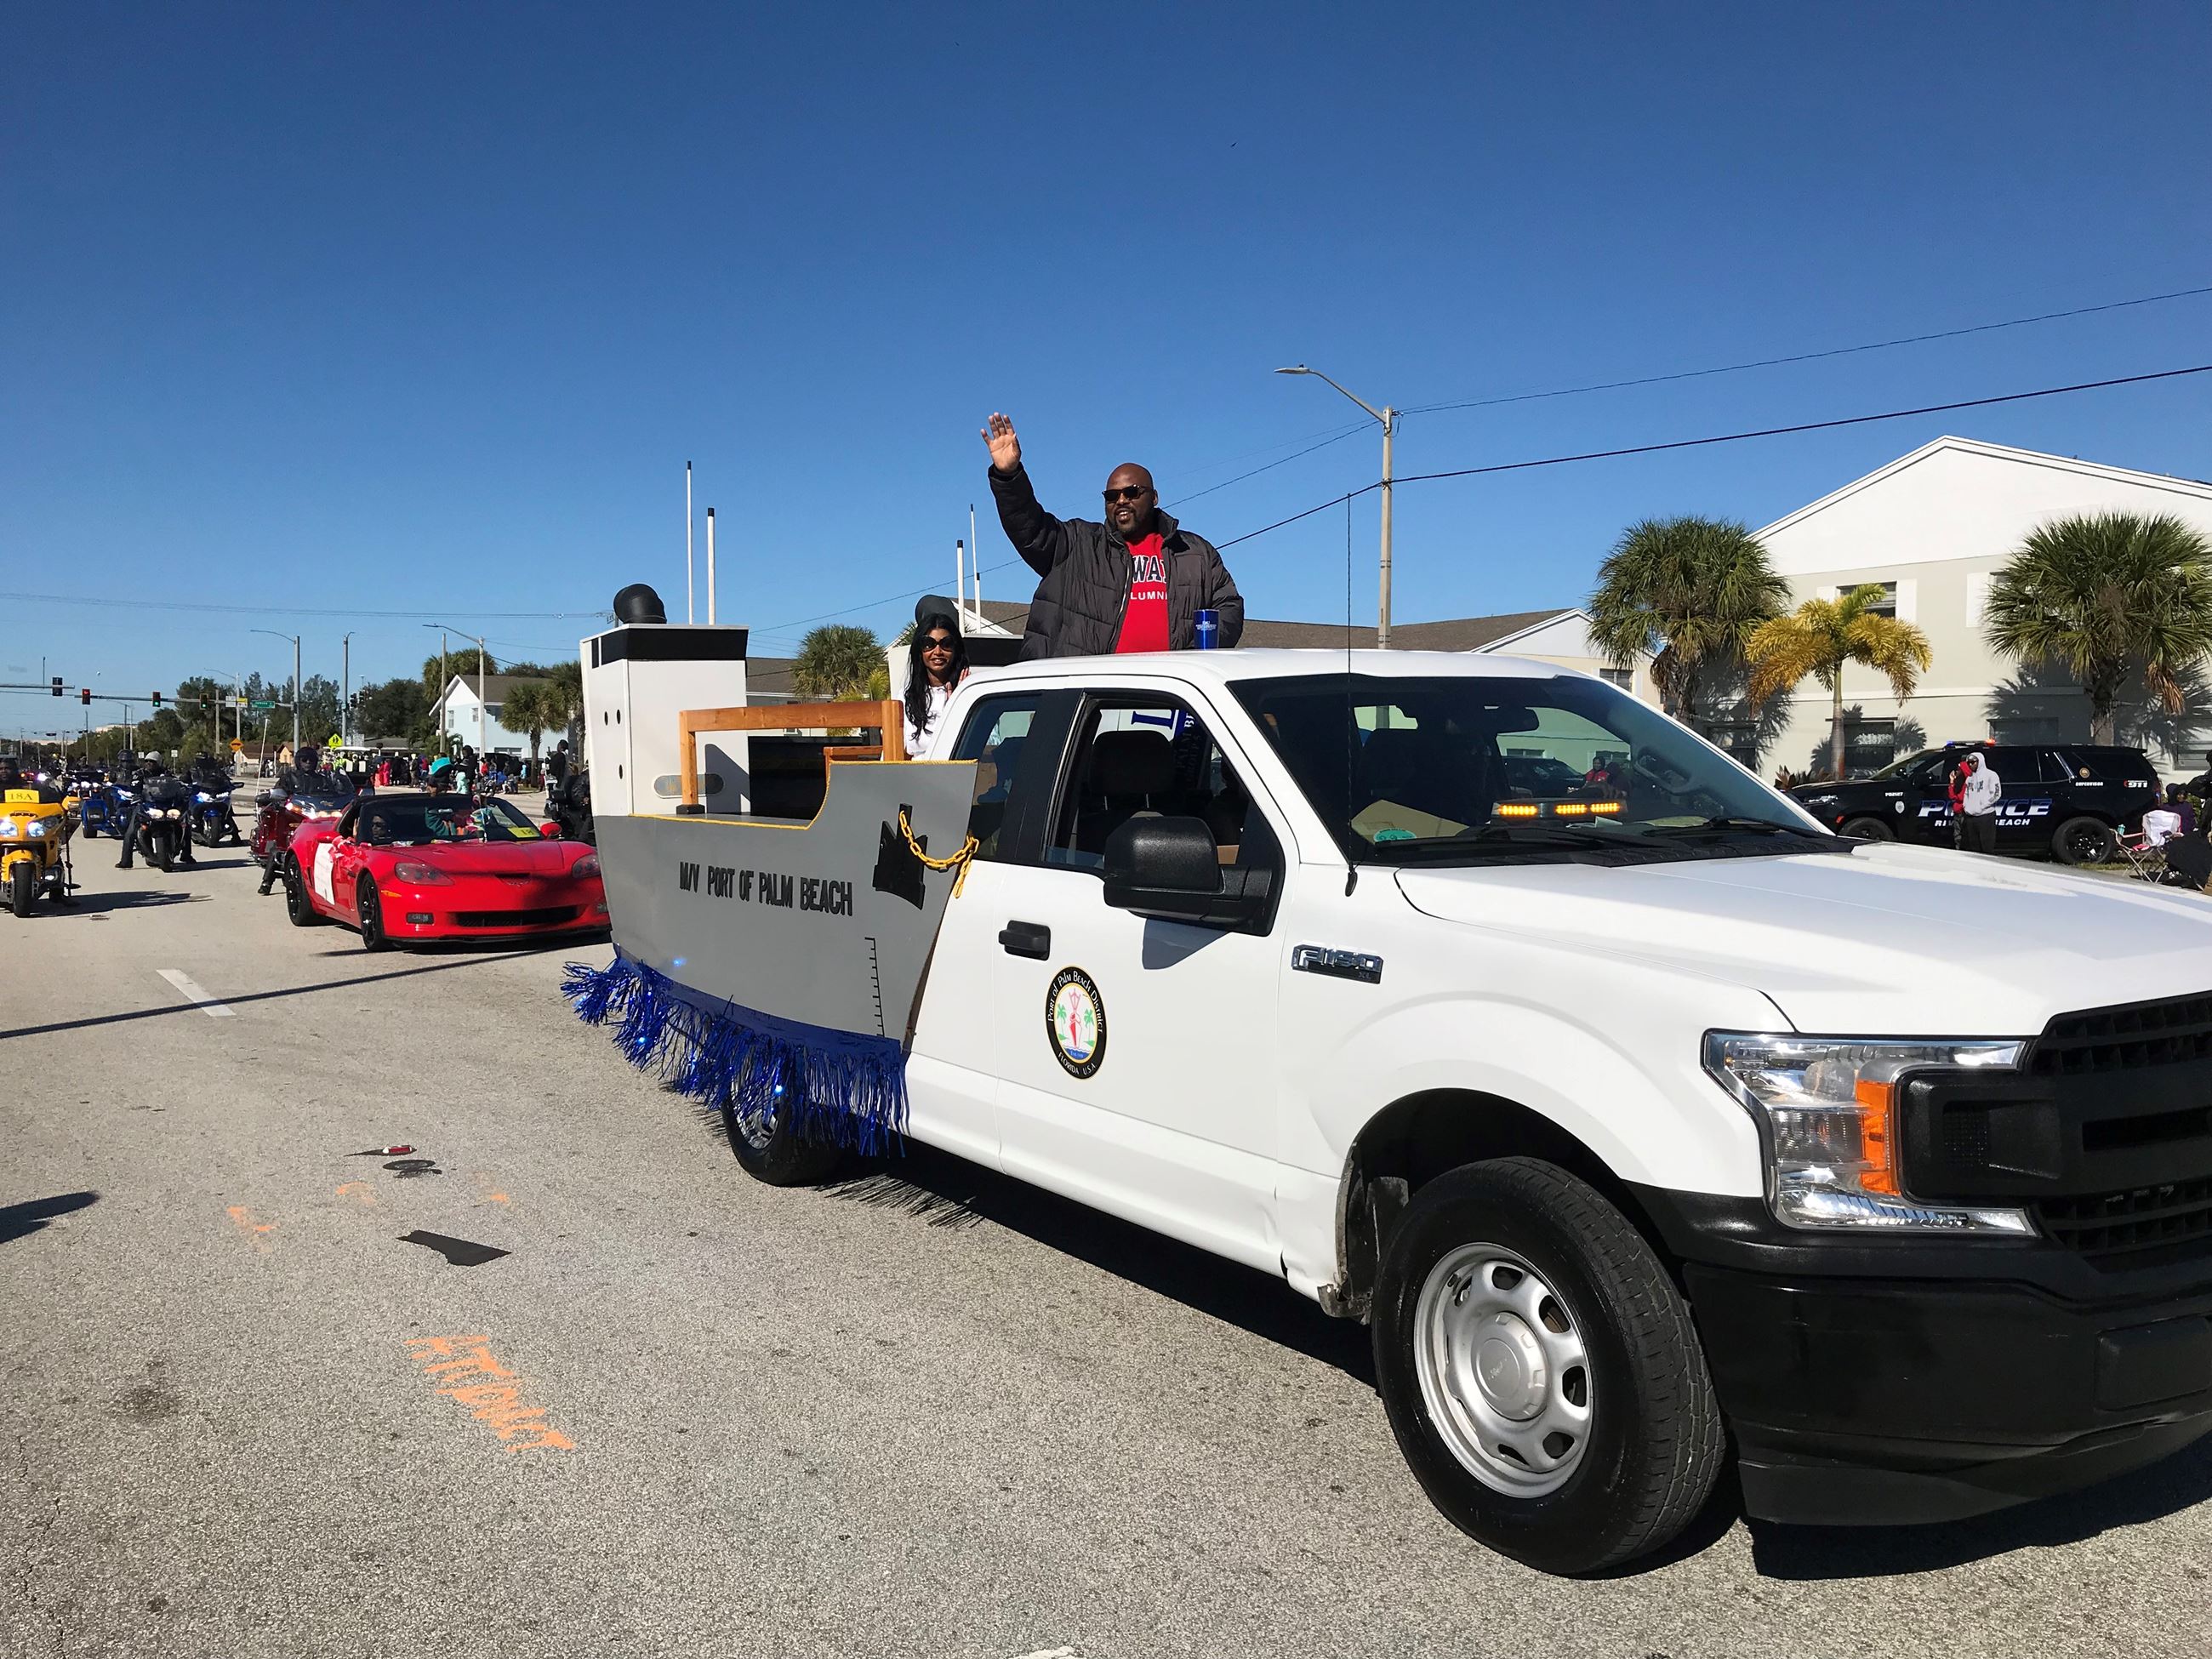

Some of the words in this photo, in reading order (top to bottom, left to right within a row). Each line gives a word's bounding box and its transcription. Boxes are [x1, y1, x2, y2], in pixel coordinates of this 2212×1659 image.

[707, 865, 735, 898] PORT
[738, 869, 755, 903] OF
[759, 872, 793, 909] PALM
[800, 876, 852, 916] BEACH
[1058, 1052, 1080, 1075] FLORIDA
